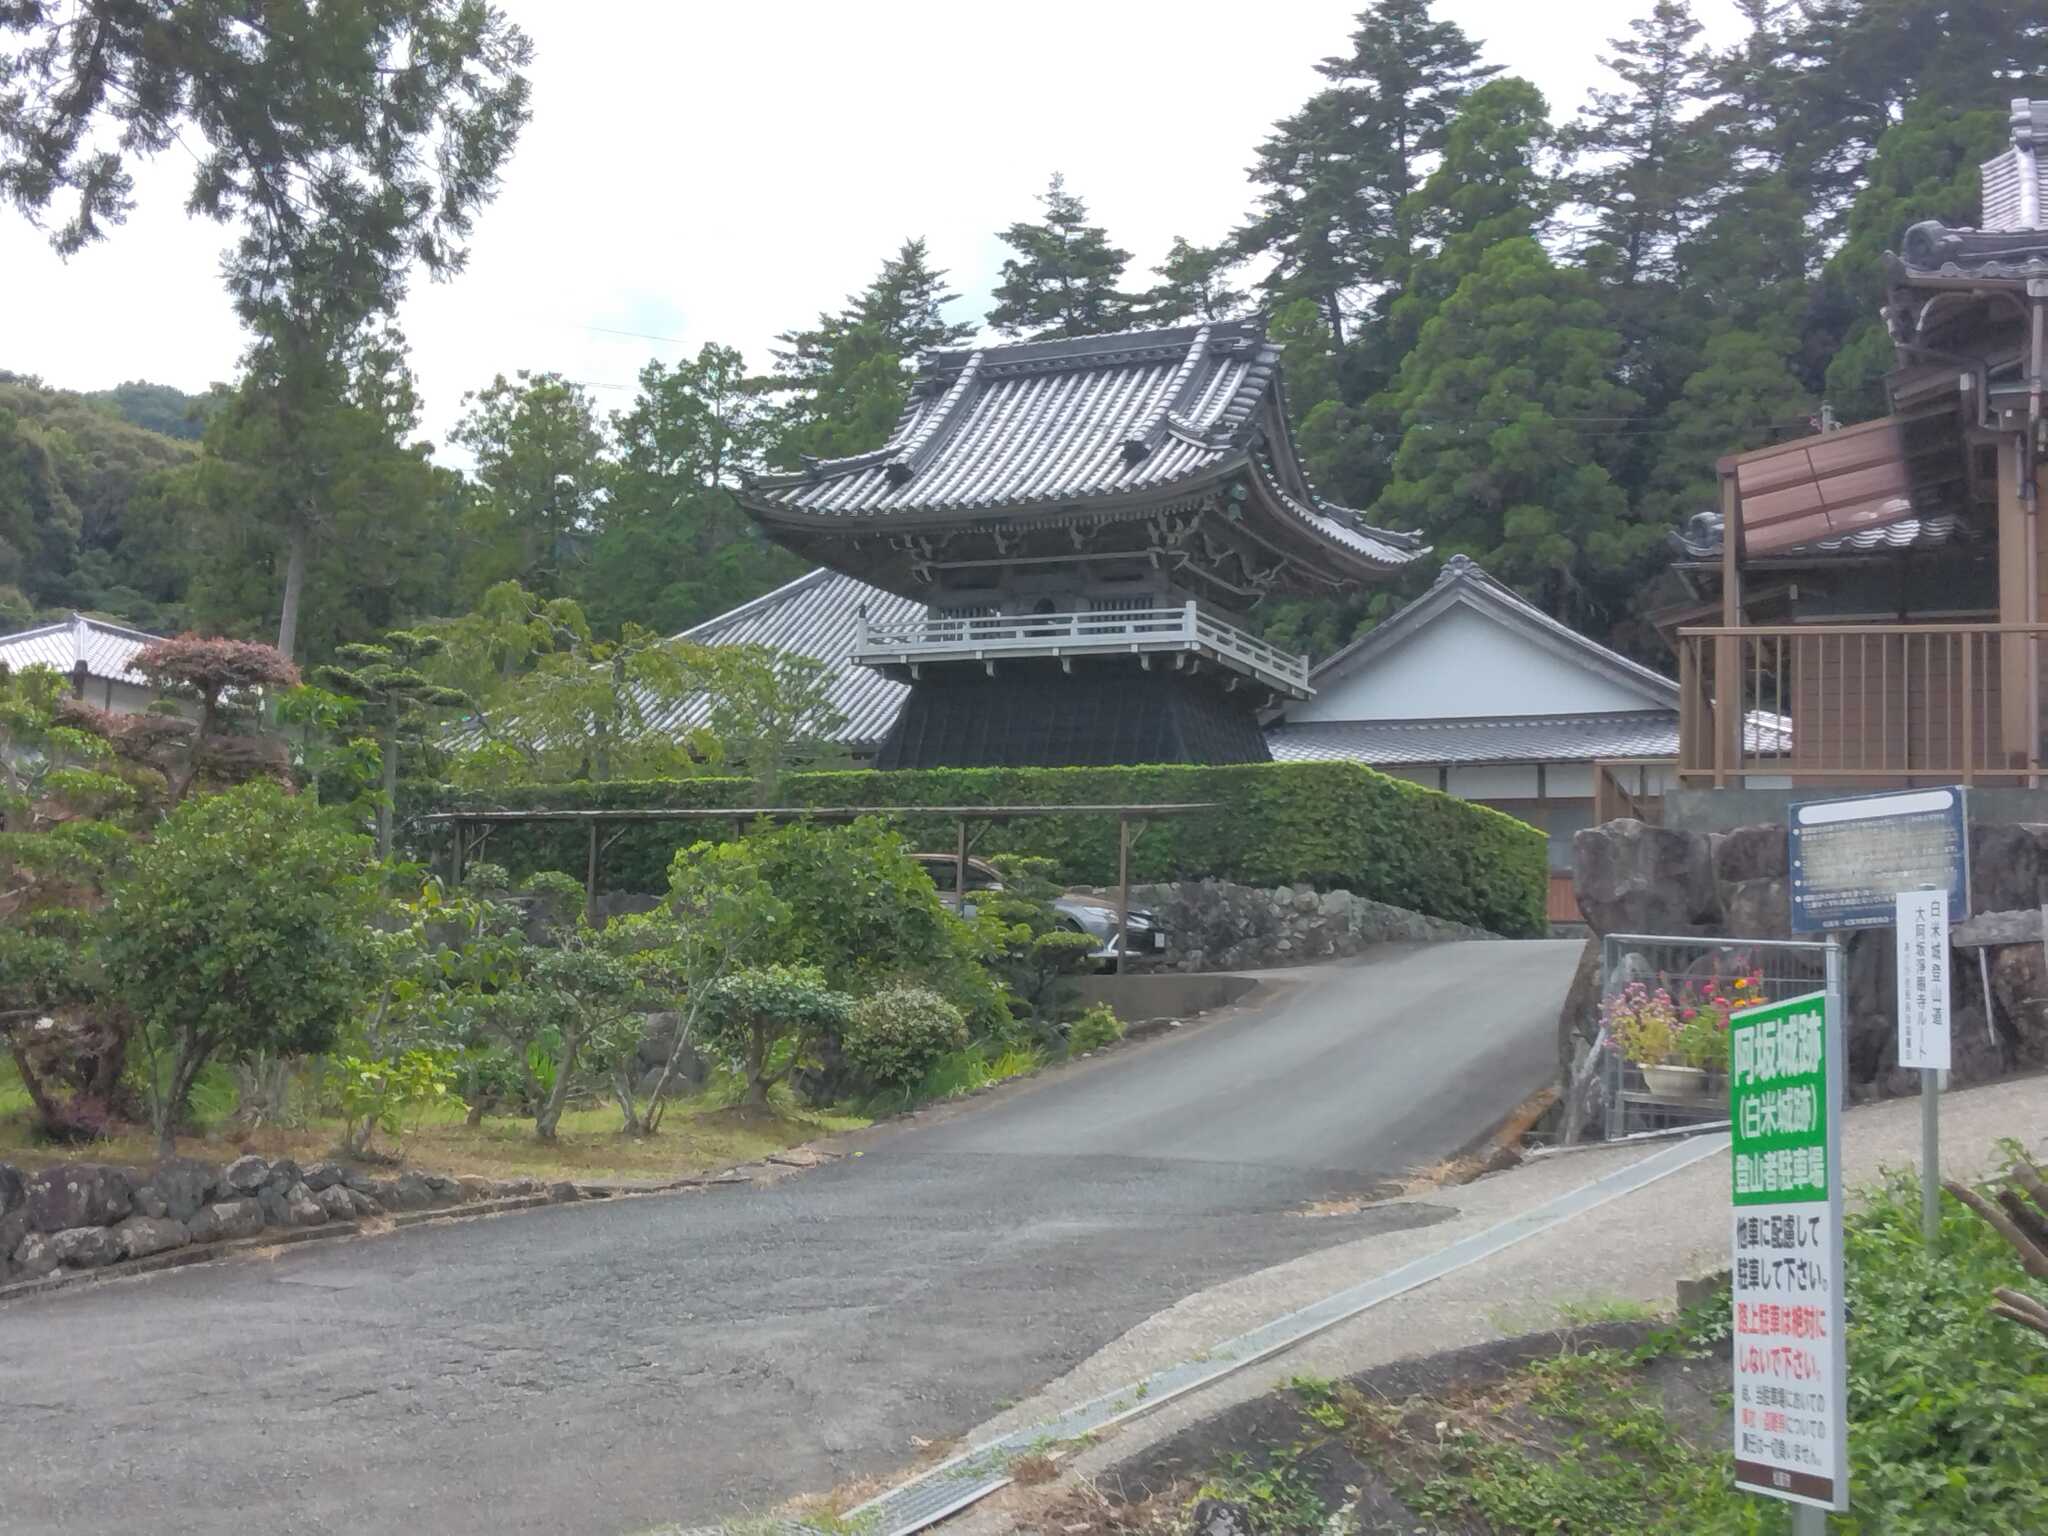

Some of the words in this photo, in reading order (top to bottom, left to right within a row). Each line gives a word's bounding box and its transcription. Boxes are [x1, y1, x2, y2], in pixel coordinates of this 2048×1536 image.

[1734, 1010, 1823, 1087] 阿坂城跡
[1736, 1147, 1825, 1193] 登山者駐車場
[1737, 1215, 1820, 1249] 他車に配慮して
[1737, 1258, 1828, 1292] 駐車して下さい。
[1739, 1343, 1821, 1382] しないで下さい。
